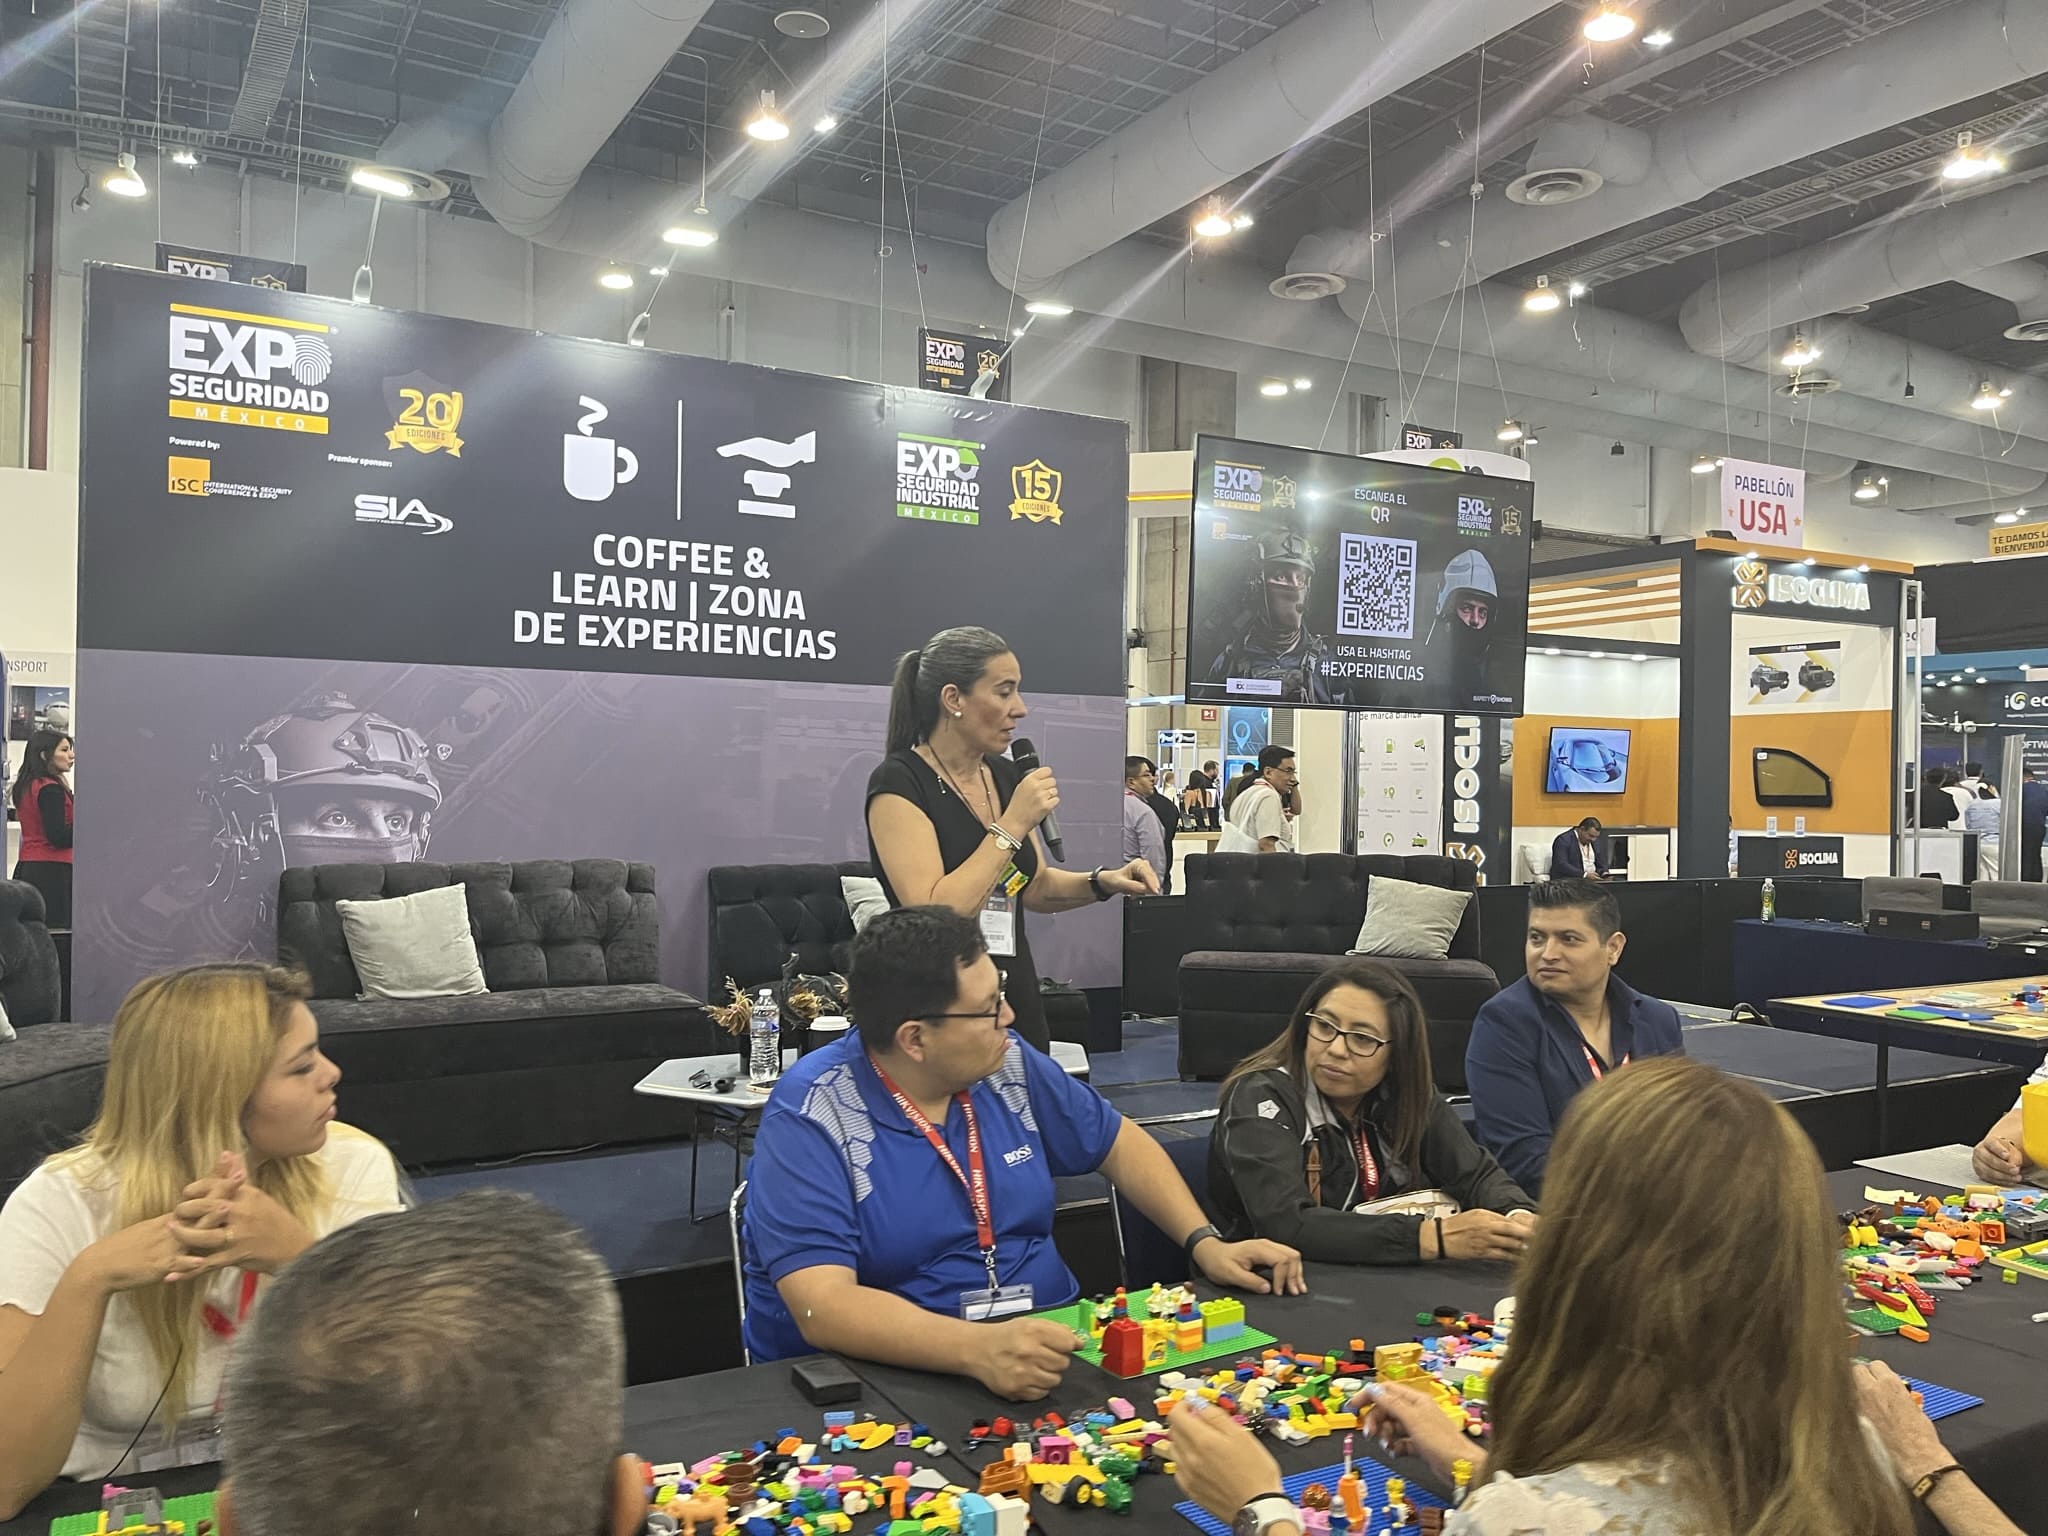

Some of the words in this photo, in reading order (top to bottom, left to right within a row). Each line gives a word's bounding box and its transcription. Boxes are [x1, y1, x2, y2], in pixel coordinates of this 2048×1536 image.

[169, 316, 332, 386] EXPO
[926, 340, 964, 361] EXPO
[926, 357, 964, 369] SEGURIDAD
[169, 373, 330, 413] SEGURIDAD
[195, 405, 305, 430] MÉXICO
[399, 388, 453, 429] 20
[169, 436, 206, 448] Powered
[207, 441, 221, 450] by:
[406, 428, 446, 441] EDICIONES
[328, 453, 359, 463] Premier
[360, 458, 392, 467] sponsor:
[897, 441, 980, 481] EXPO
[204, 481, 259, 492] INTERNATIONAL
[260, 486, 293, 496] SECURITY
[897, 474, 980, 497] SEGURIDAD
[1021, 469, 1052, 500] 15
[1214, 465, 1263, 492] EXPO
[1735, 475, 1794, 498] PABELLÓN
[204, 487, 251, 498] CONFERENCE
[259, 492, 278, 500] EXPO
[897, 487, 980, 511] INDUSTRIAL
[1213, 488, 1262, 503] SEGURIDAD
[1276, 481, 1294, 497] 20
[1354, 488, 1395, 504] ESCANEA
[1397, 494, 1408, 505] EL
[354, 494, 436, 524] SIA
[904, 506, 971, 523] MÉXICO
[1022, 501, 1051, 513] EDICIONES
[1370, 506, 1391, 524] QR
[1740, 498, 1787, 536] USA
[1457, 520, 1491, 532] INDUSTRIAL
[1458, 513, 1492, 524] SEGURIDAD
[1504, 511, 1519, 526] 15
[1992, 536, 2005, 545] TE
[2006, 531, 2040, 543] DAMOS
[593, 533, 734, 576] COFFEE
[743, 547, 771, 579] &
[552, 571, 677, 611] LEARN
[708, 583, 806, 621] ZONA
[1769, 573, 1871, 611] ISOCLIMA
[513, 610, 566, 645] DE
[578, 614, 837, 661] EXPERIENCIAS
[1337, 645, 1355, 657] USA
[1357, 647, 1368, 658] EL
[1369, 648, 1411, 660] HASHTAG
[1320, 661, 1425, 681] #EXPERIENCIAS
[1799, 852, 1838, 865] ISOCLIMA
[892, 1092, 933, 1133] HIKVISION
[963, 1103, 980, 1153] HIKVISION
[1003, 1146, 1032, 1164] BOSS
